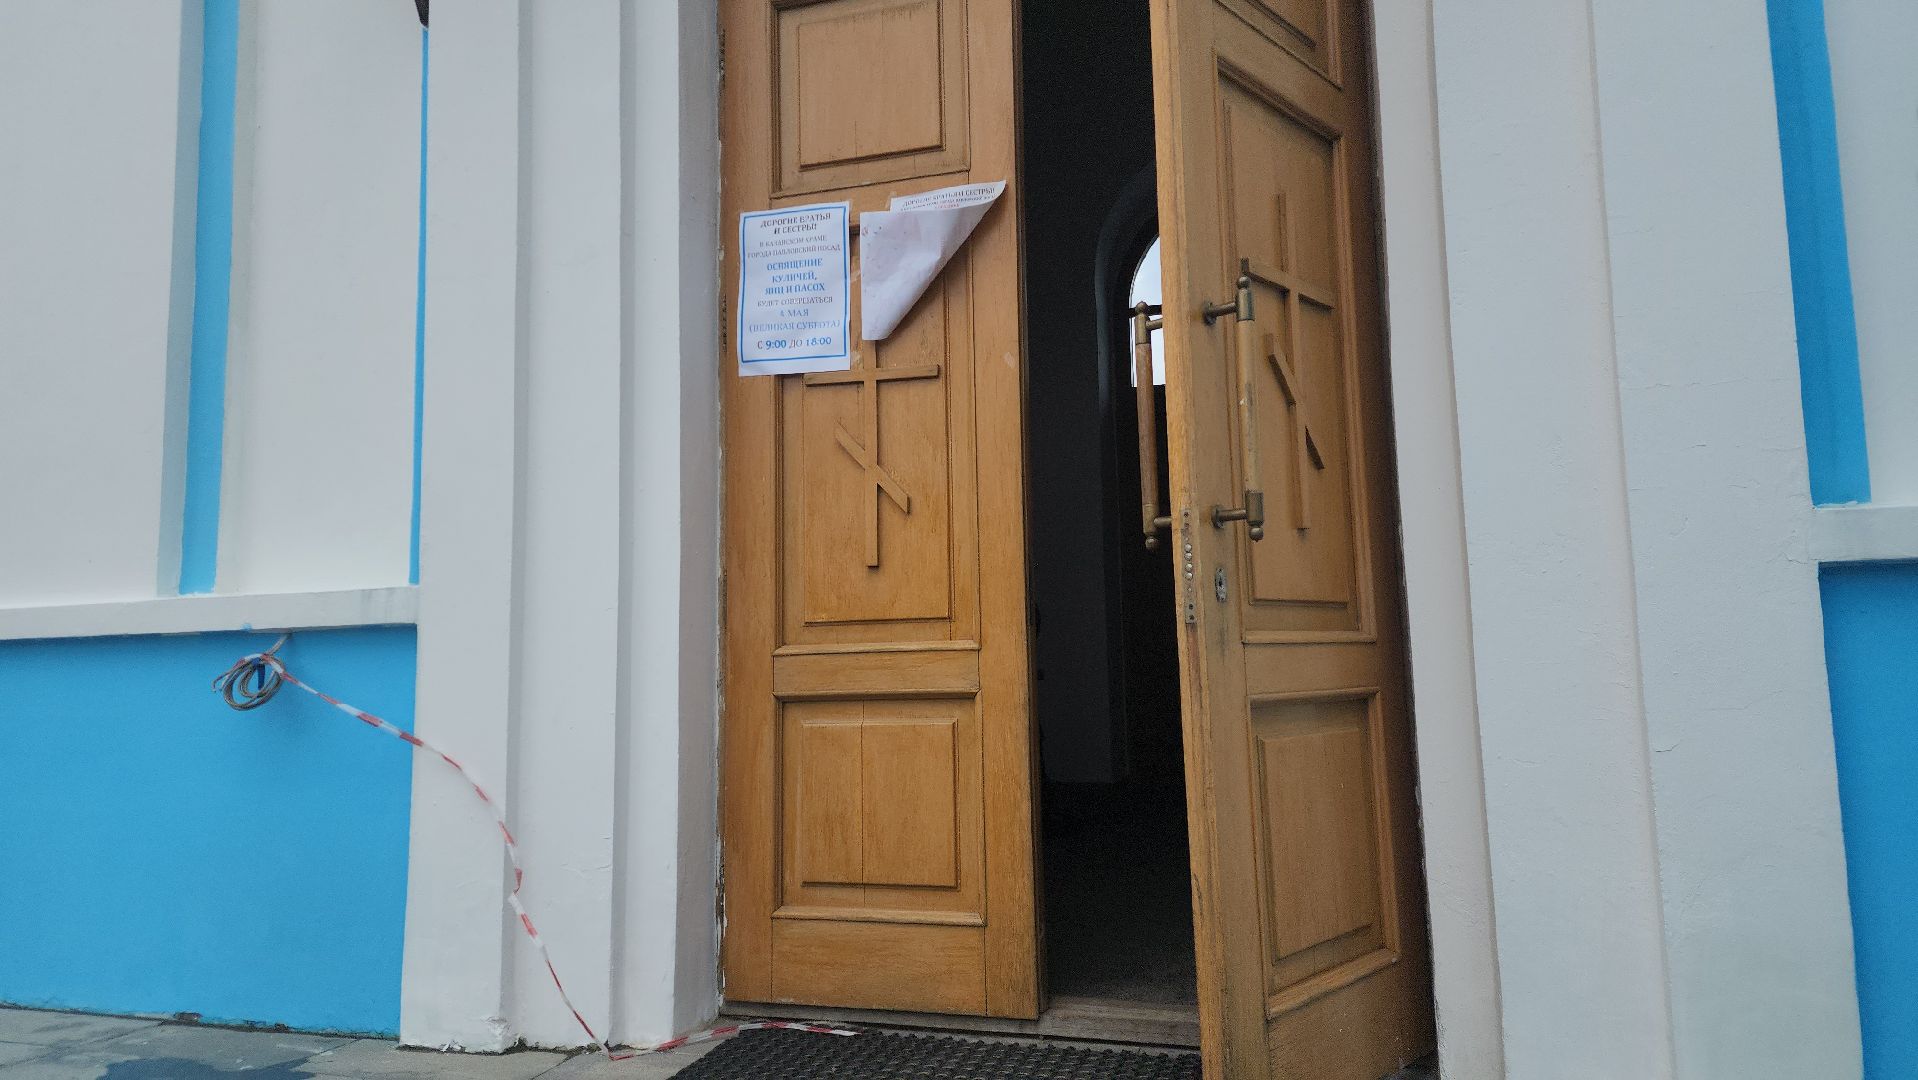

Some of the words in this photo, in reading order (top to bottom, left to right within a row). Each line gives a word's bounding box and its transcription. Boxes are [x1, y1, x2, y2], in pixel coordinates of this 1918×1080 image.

[787, 308, 809, 317] МАЯ
[765, 339, 787, 350] 9:00
[788, 339, 803, 349] ДО
[805, 336, 832, 346] 18:00
